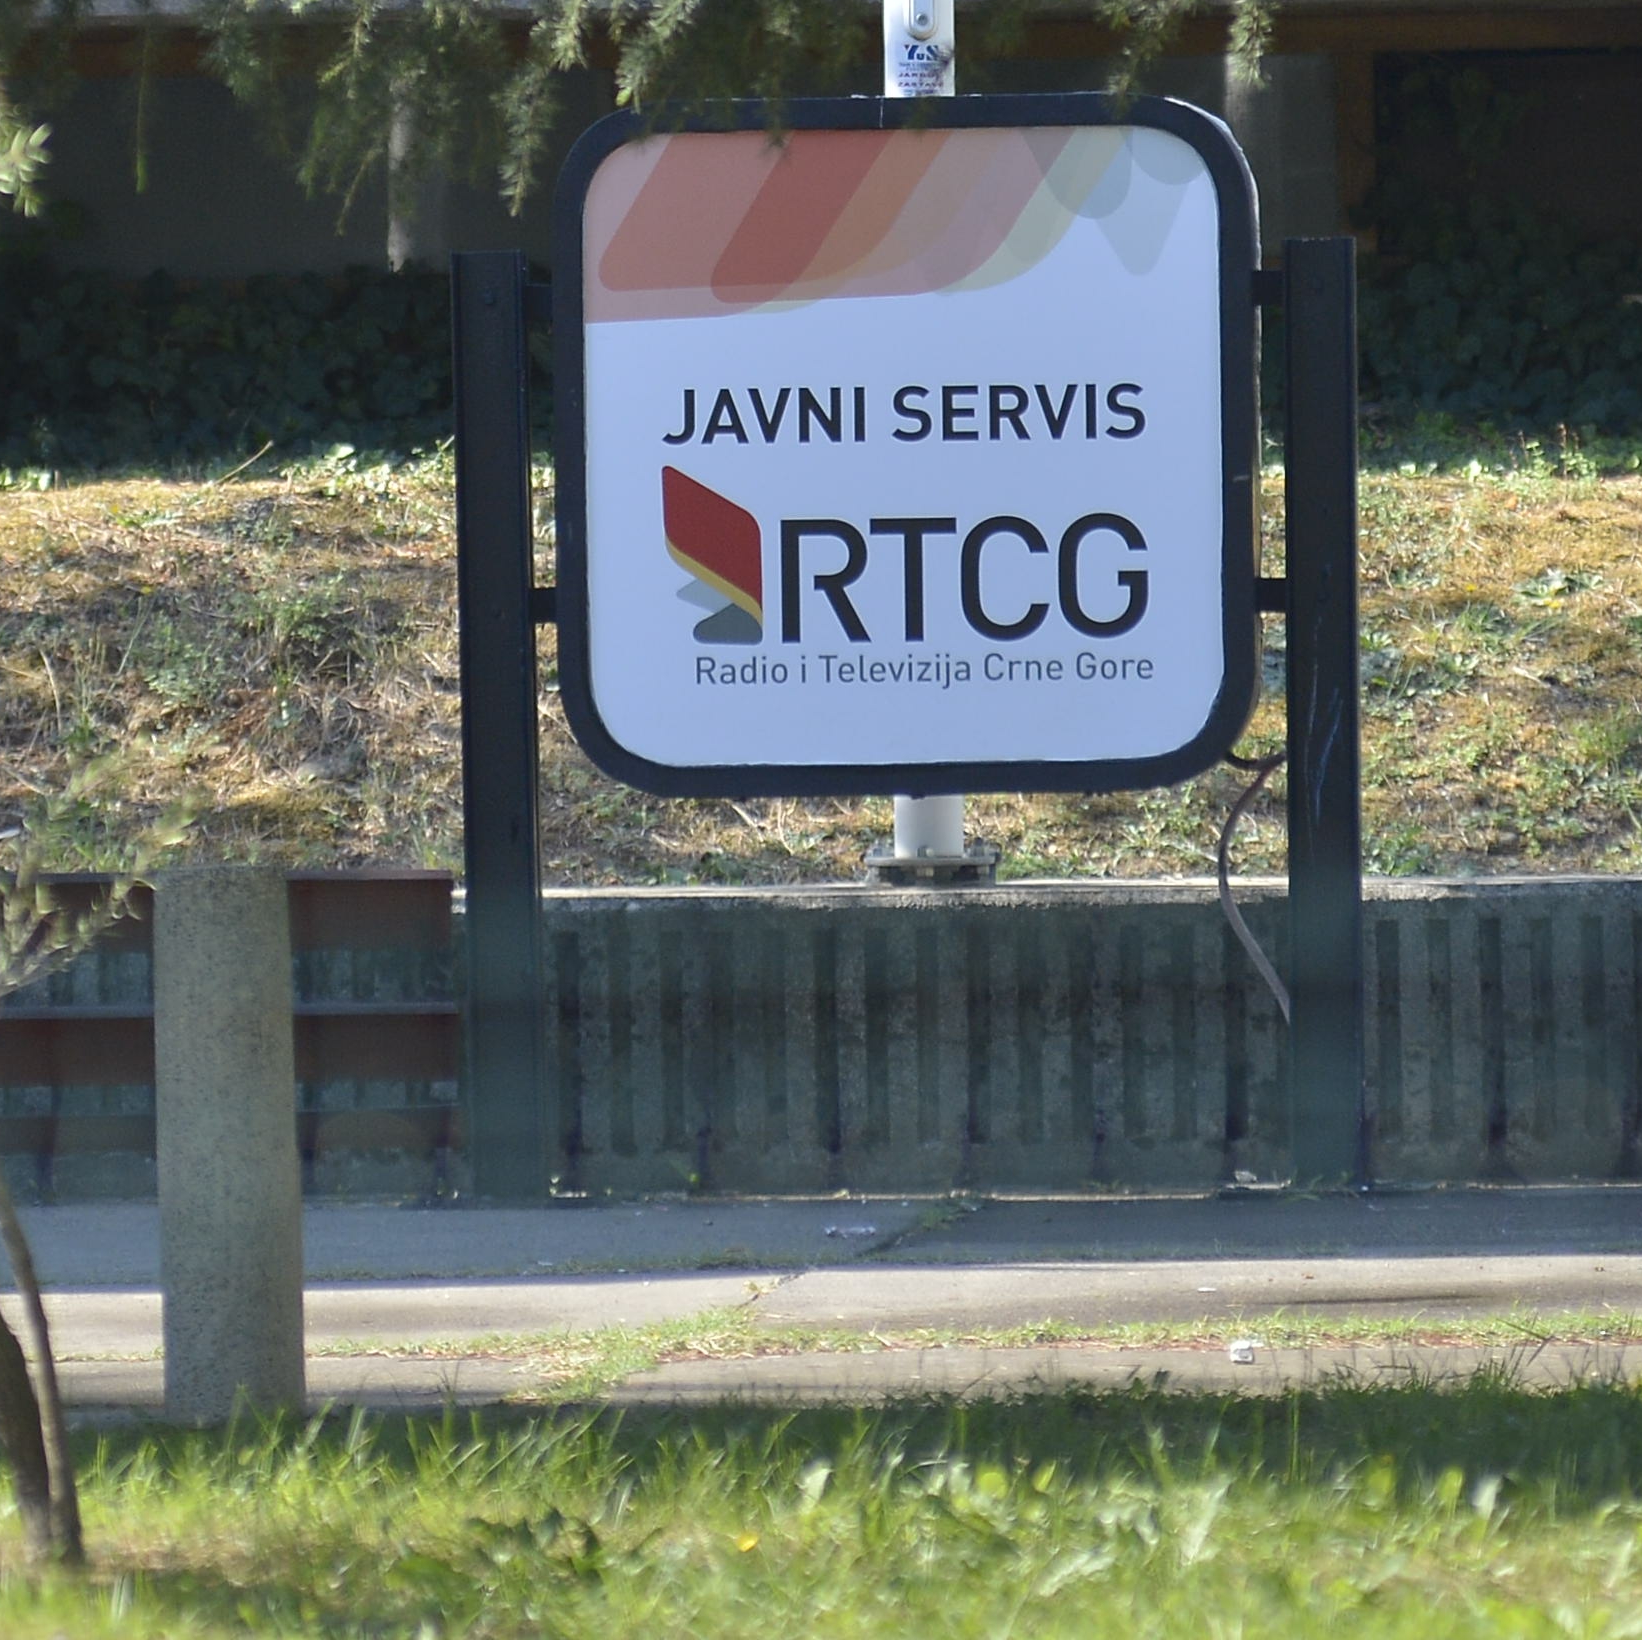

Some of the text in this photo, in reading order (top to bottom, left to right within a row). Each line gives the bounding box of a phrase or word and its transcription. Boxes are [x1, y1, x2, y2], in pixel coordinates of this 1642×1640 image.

[661, 382, 1147, 446] JAVNI SERVIS
[779, 512, 1150, 646] RTCG
[696, 651, 1154, 690] Radio i Televizija Crne Gore
